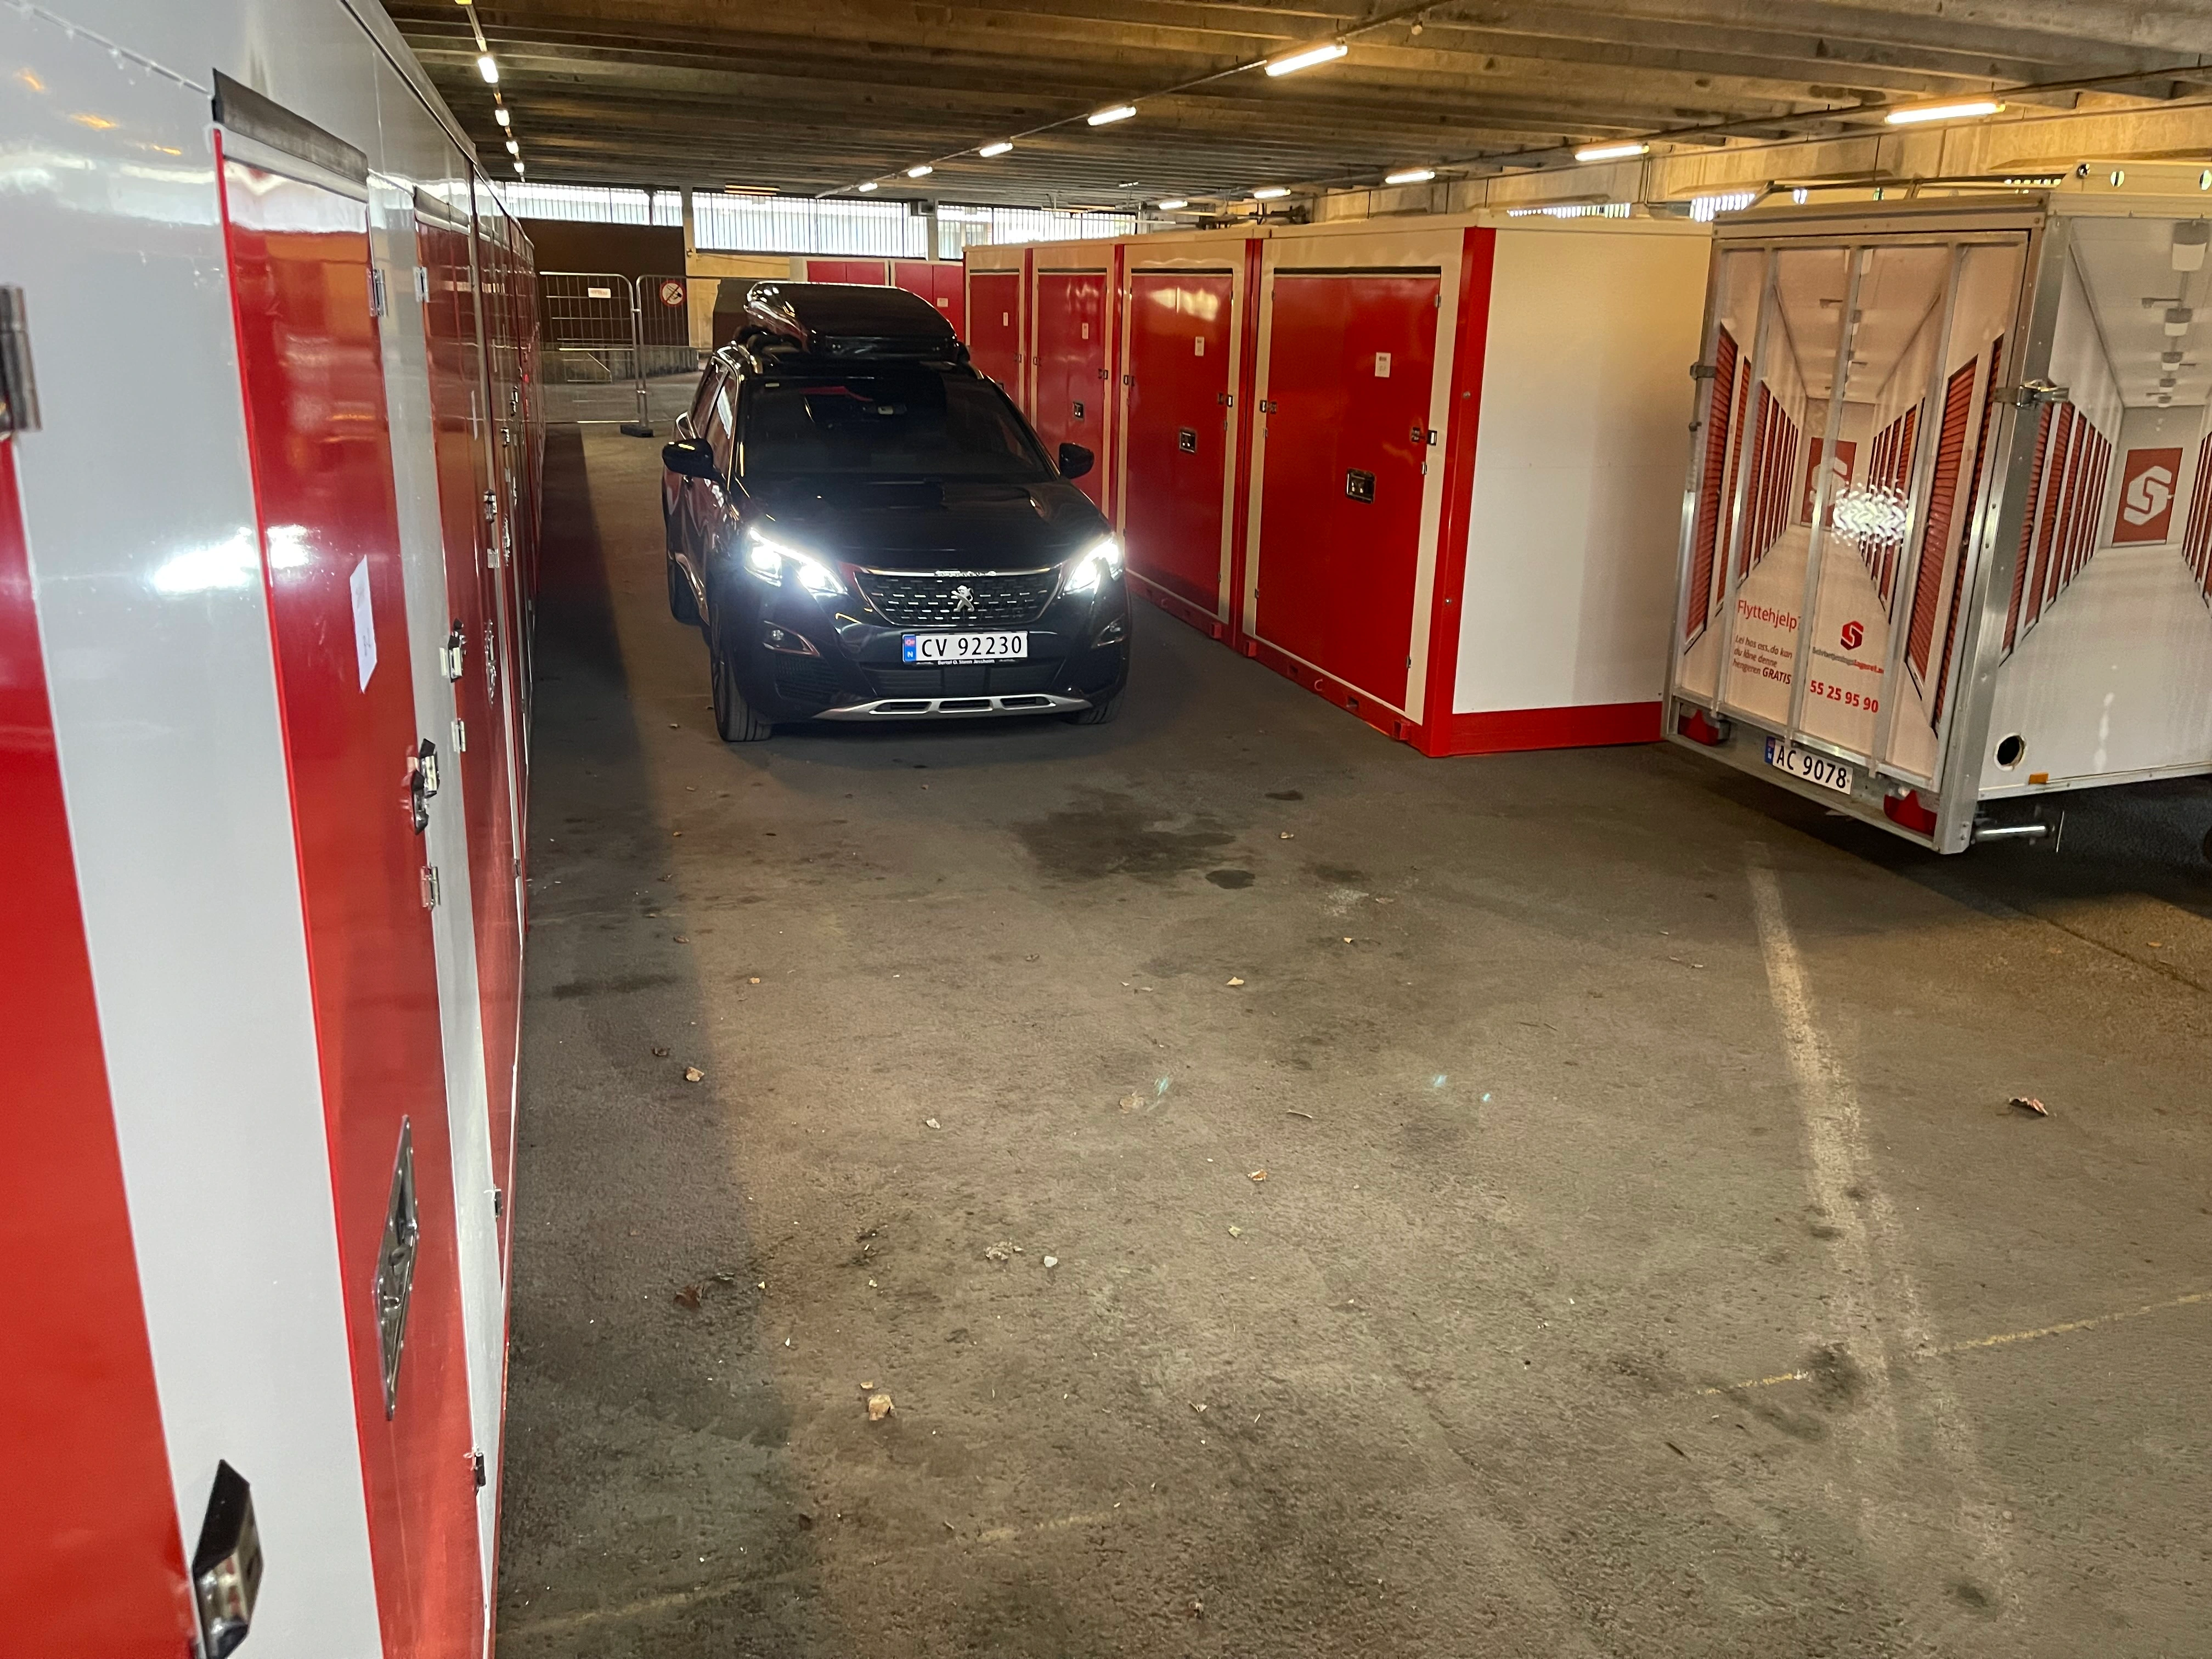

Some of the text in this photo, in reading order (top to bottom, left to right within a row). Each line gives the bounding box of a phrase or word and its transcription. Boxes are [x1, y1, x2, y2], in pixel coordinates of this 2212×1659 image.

[1737, 600, 1801, 632] Flyttehjelp
[922, 635, 1022, 657] CV 92230
[1734, 647, 1742, 656] du
[1758, 654, 1778, 668] denne
[1735, 635, 1745, 645] Lei
[1745, 637, 1757, 648] hos
[1780, 647, 1792, 659] kan
[1733, 658, 1792, 685] hengeren GRATIS
[1810, 680, 1879, 713] 55 25 95 90
[1776, 746, 1847, 788] AC 9078
